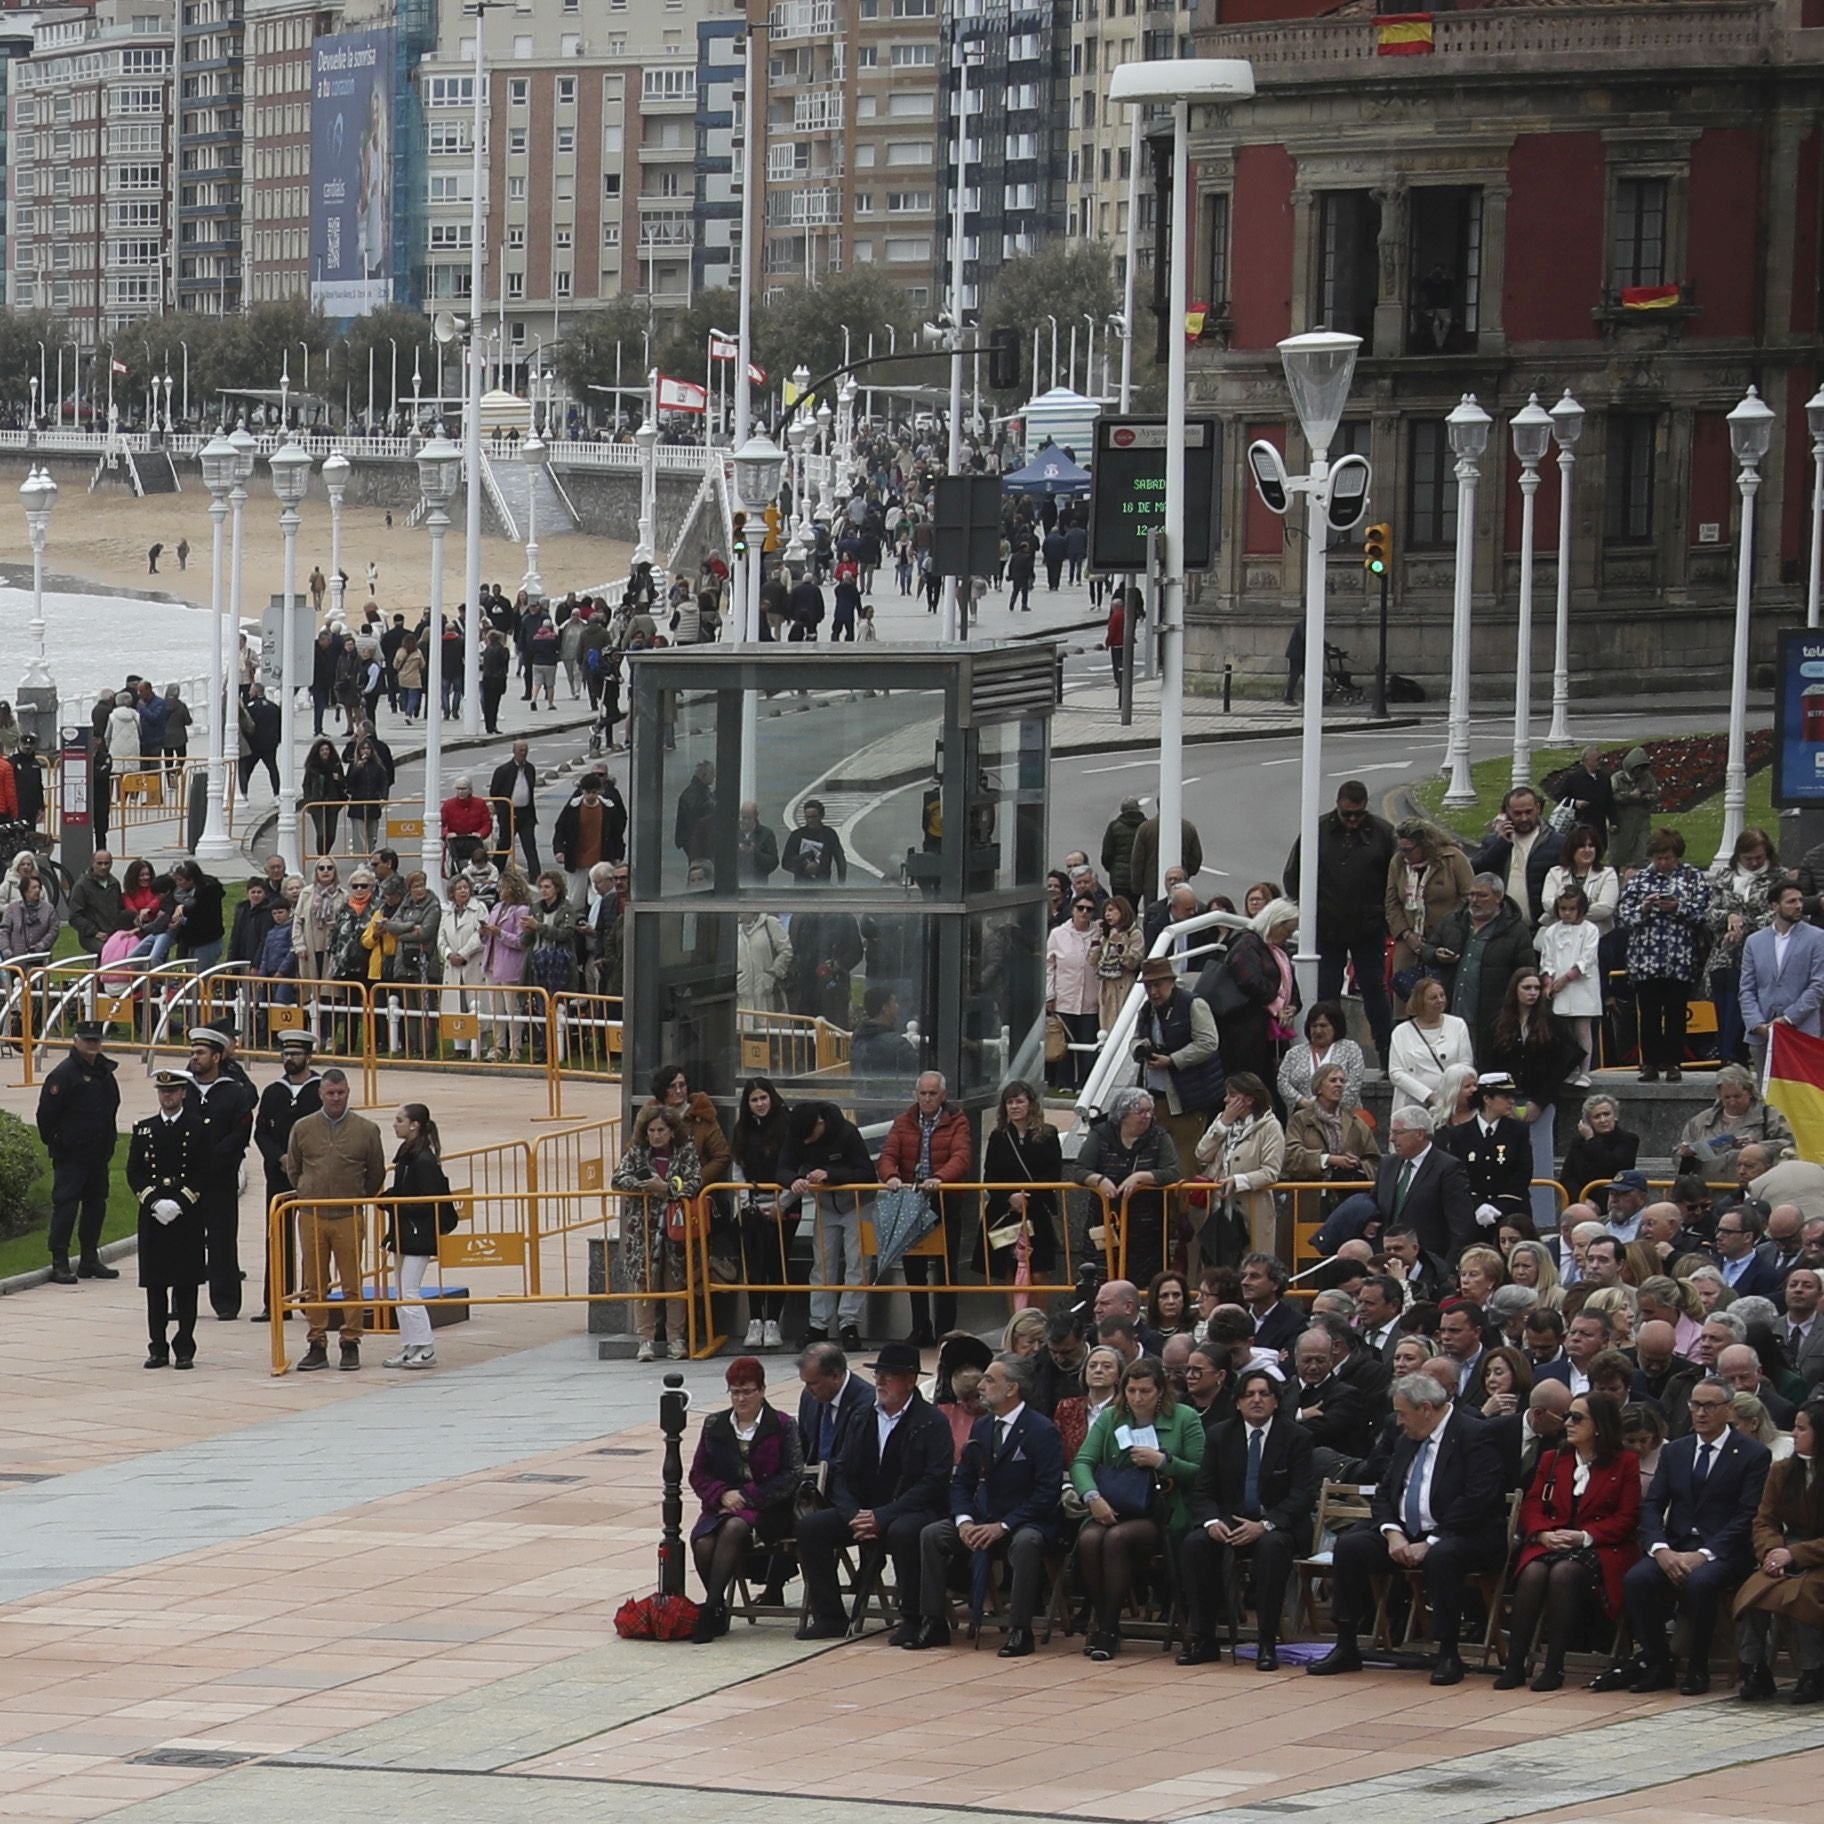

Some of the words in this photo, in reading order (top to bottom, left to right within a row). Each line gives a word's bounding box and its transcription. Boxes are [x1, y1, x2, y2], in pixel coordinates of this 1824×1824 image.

[317, 47, 347, 72] Devuelve
[347, 45, 353, 69] la
[354, 43, 376, 68] sonrisa
[323, 77, 331, 97] tu
[1133, 479, 1166, 490] SABAD
[1138, 502, 1150, 513] DE
